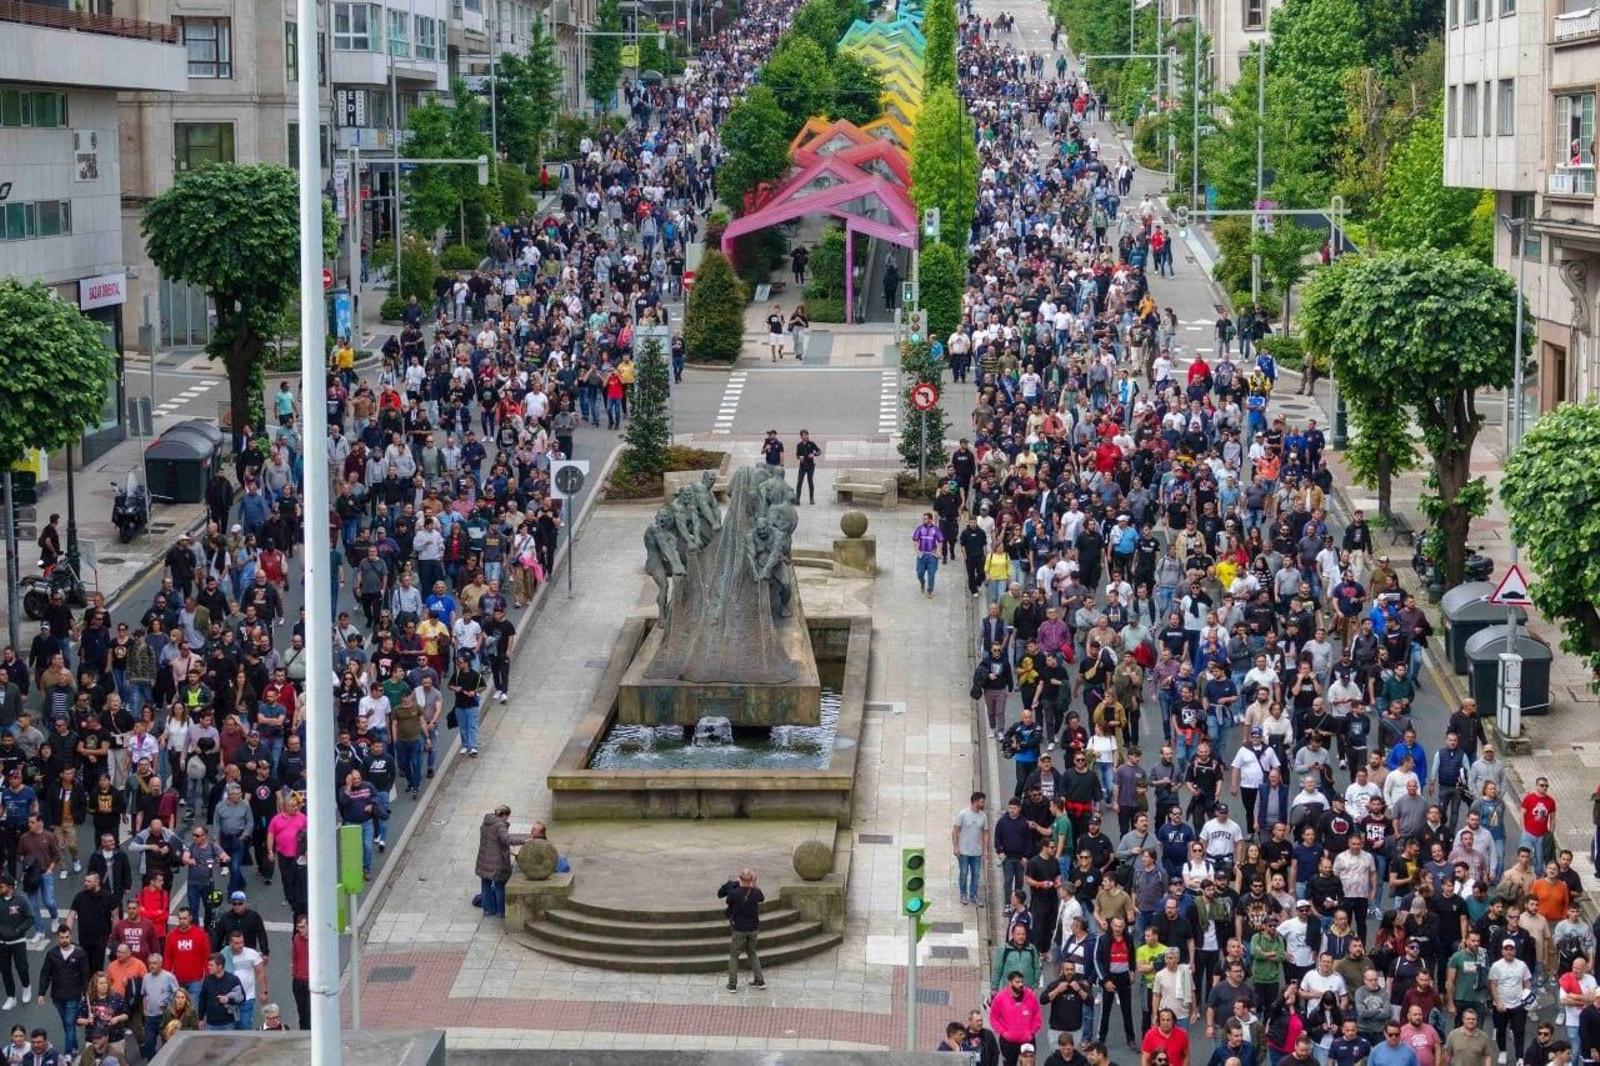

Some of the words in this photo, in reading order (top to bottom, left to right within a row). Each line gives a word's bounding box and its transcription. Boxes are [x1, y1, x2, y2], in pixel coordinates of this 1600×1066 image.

[89, 285, 102, 300] BAZAR
[102, 283, 120, 297] ORIENTAL
[124, 928, 143, 937] NEVER
[177, 939, 193, 950] HH
